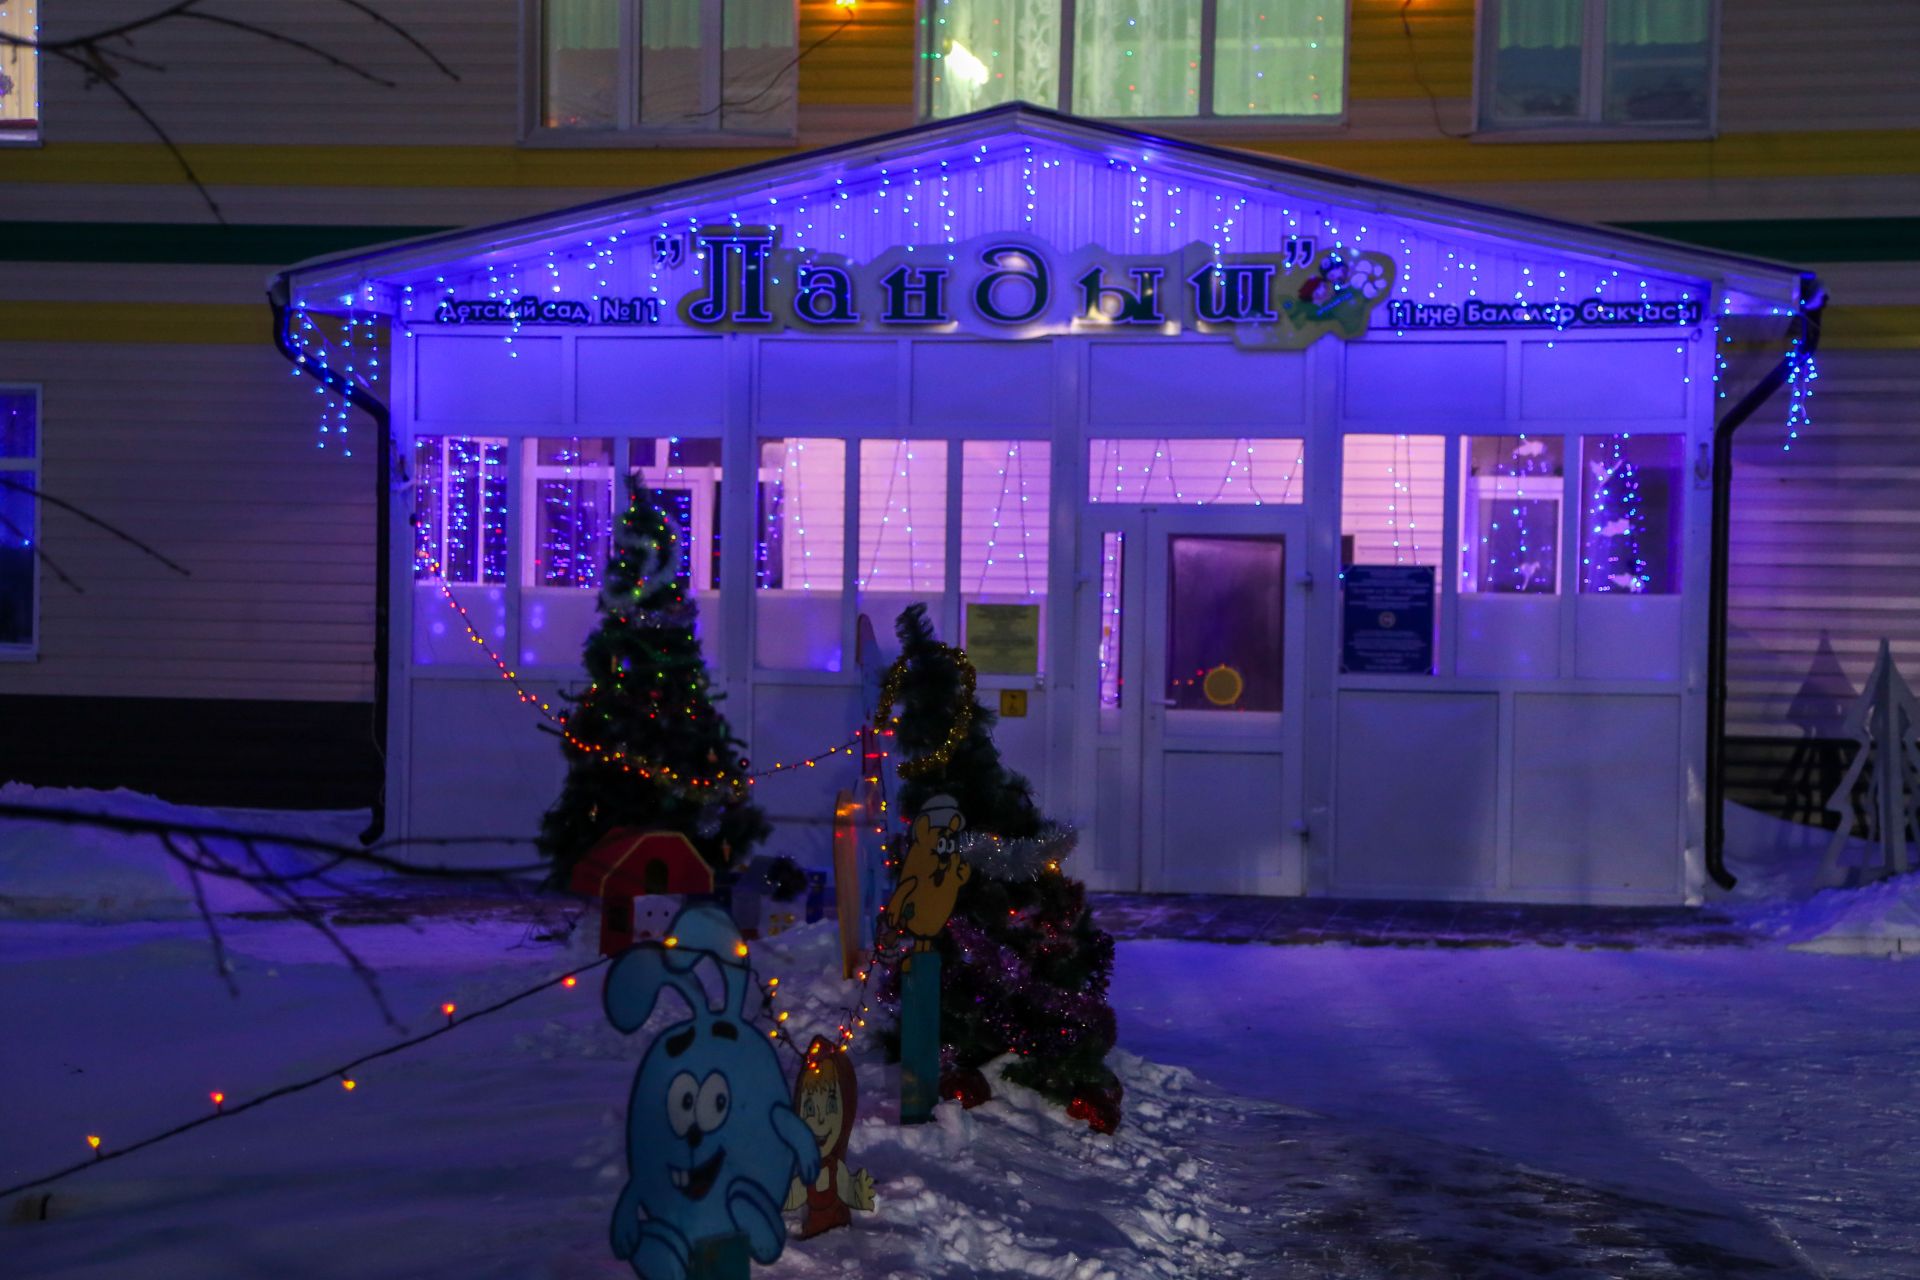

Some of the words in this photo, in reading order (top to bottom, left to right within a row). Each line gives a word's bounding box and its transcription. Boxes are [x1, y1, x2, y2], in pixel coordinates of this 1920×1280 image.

[439, 298, 536, 323] Детский
[543, 302, 592, 323] сад
[603, 299, 657, 322] №11
[1468, 301, 1575, 326] Балалар
[1582, 300, 1697, 321] бакчасы
